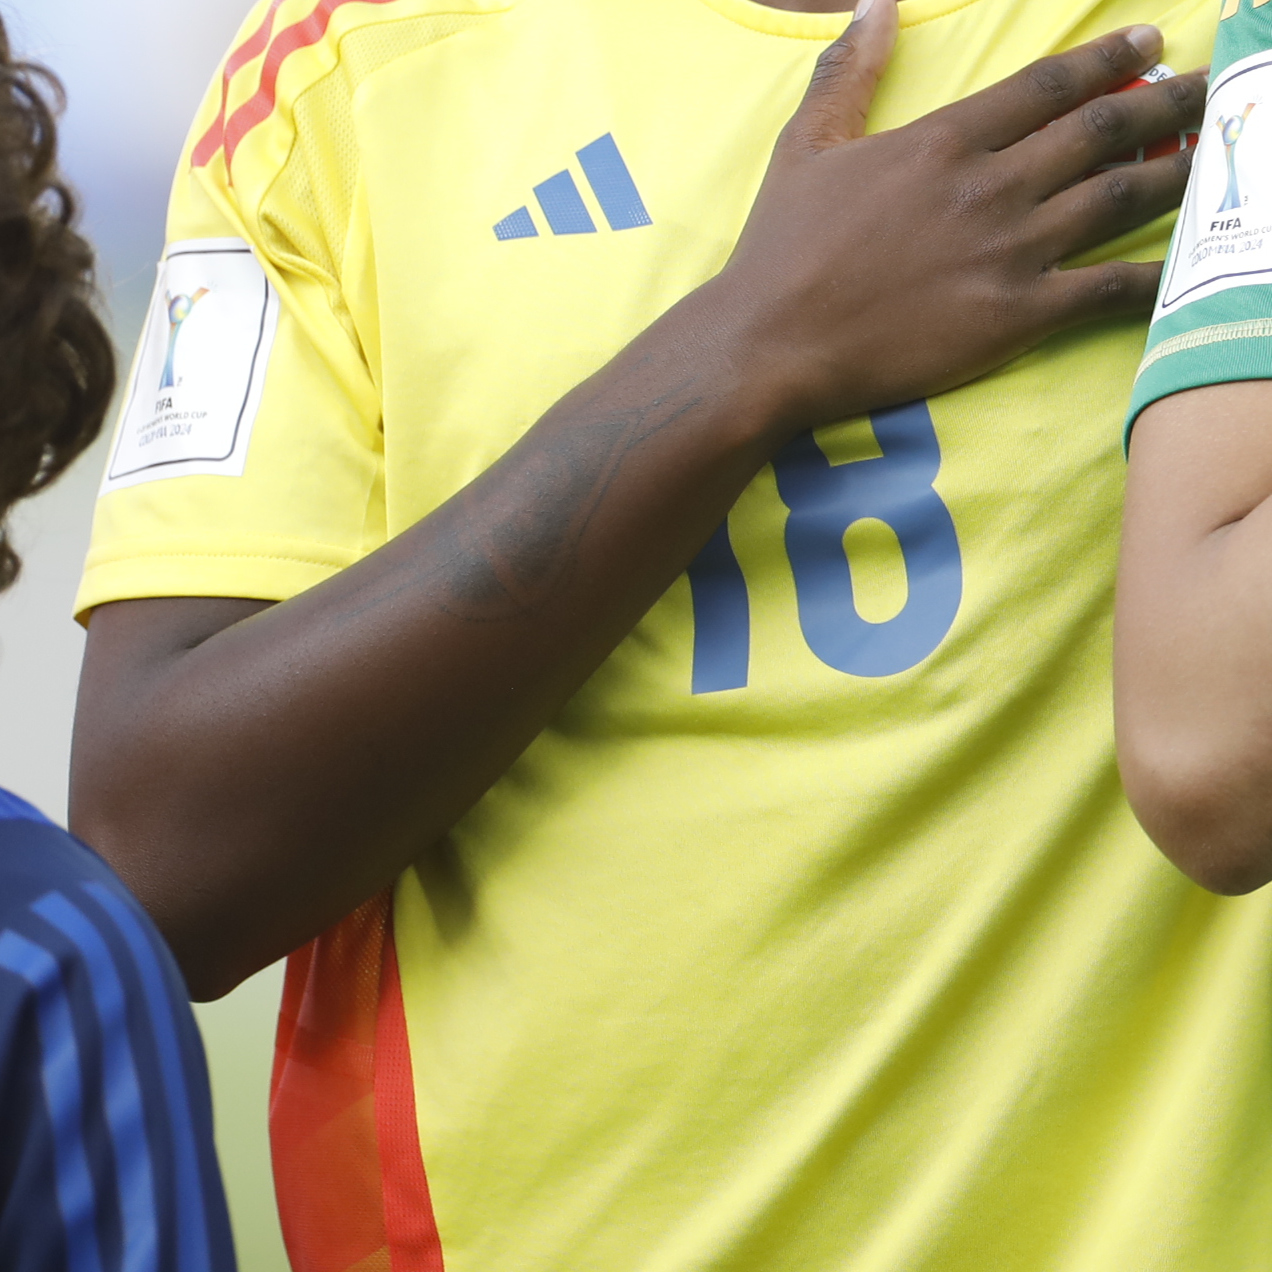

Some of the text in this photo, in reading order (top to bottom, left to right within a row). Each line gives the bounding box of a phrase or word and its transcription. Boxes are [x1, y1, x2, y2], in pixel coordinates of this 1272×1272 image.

[1209, 217, 1242, 232] FIFA
[1231, 228, 1260, 240] WORLD
[1238, 238, 1264, 254] 2024
[155, 396, 173, 415] FIFA
[191, 411, 208, 420] CUP
[686, 398, 963, 695] 18
